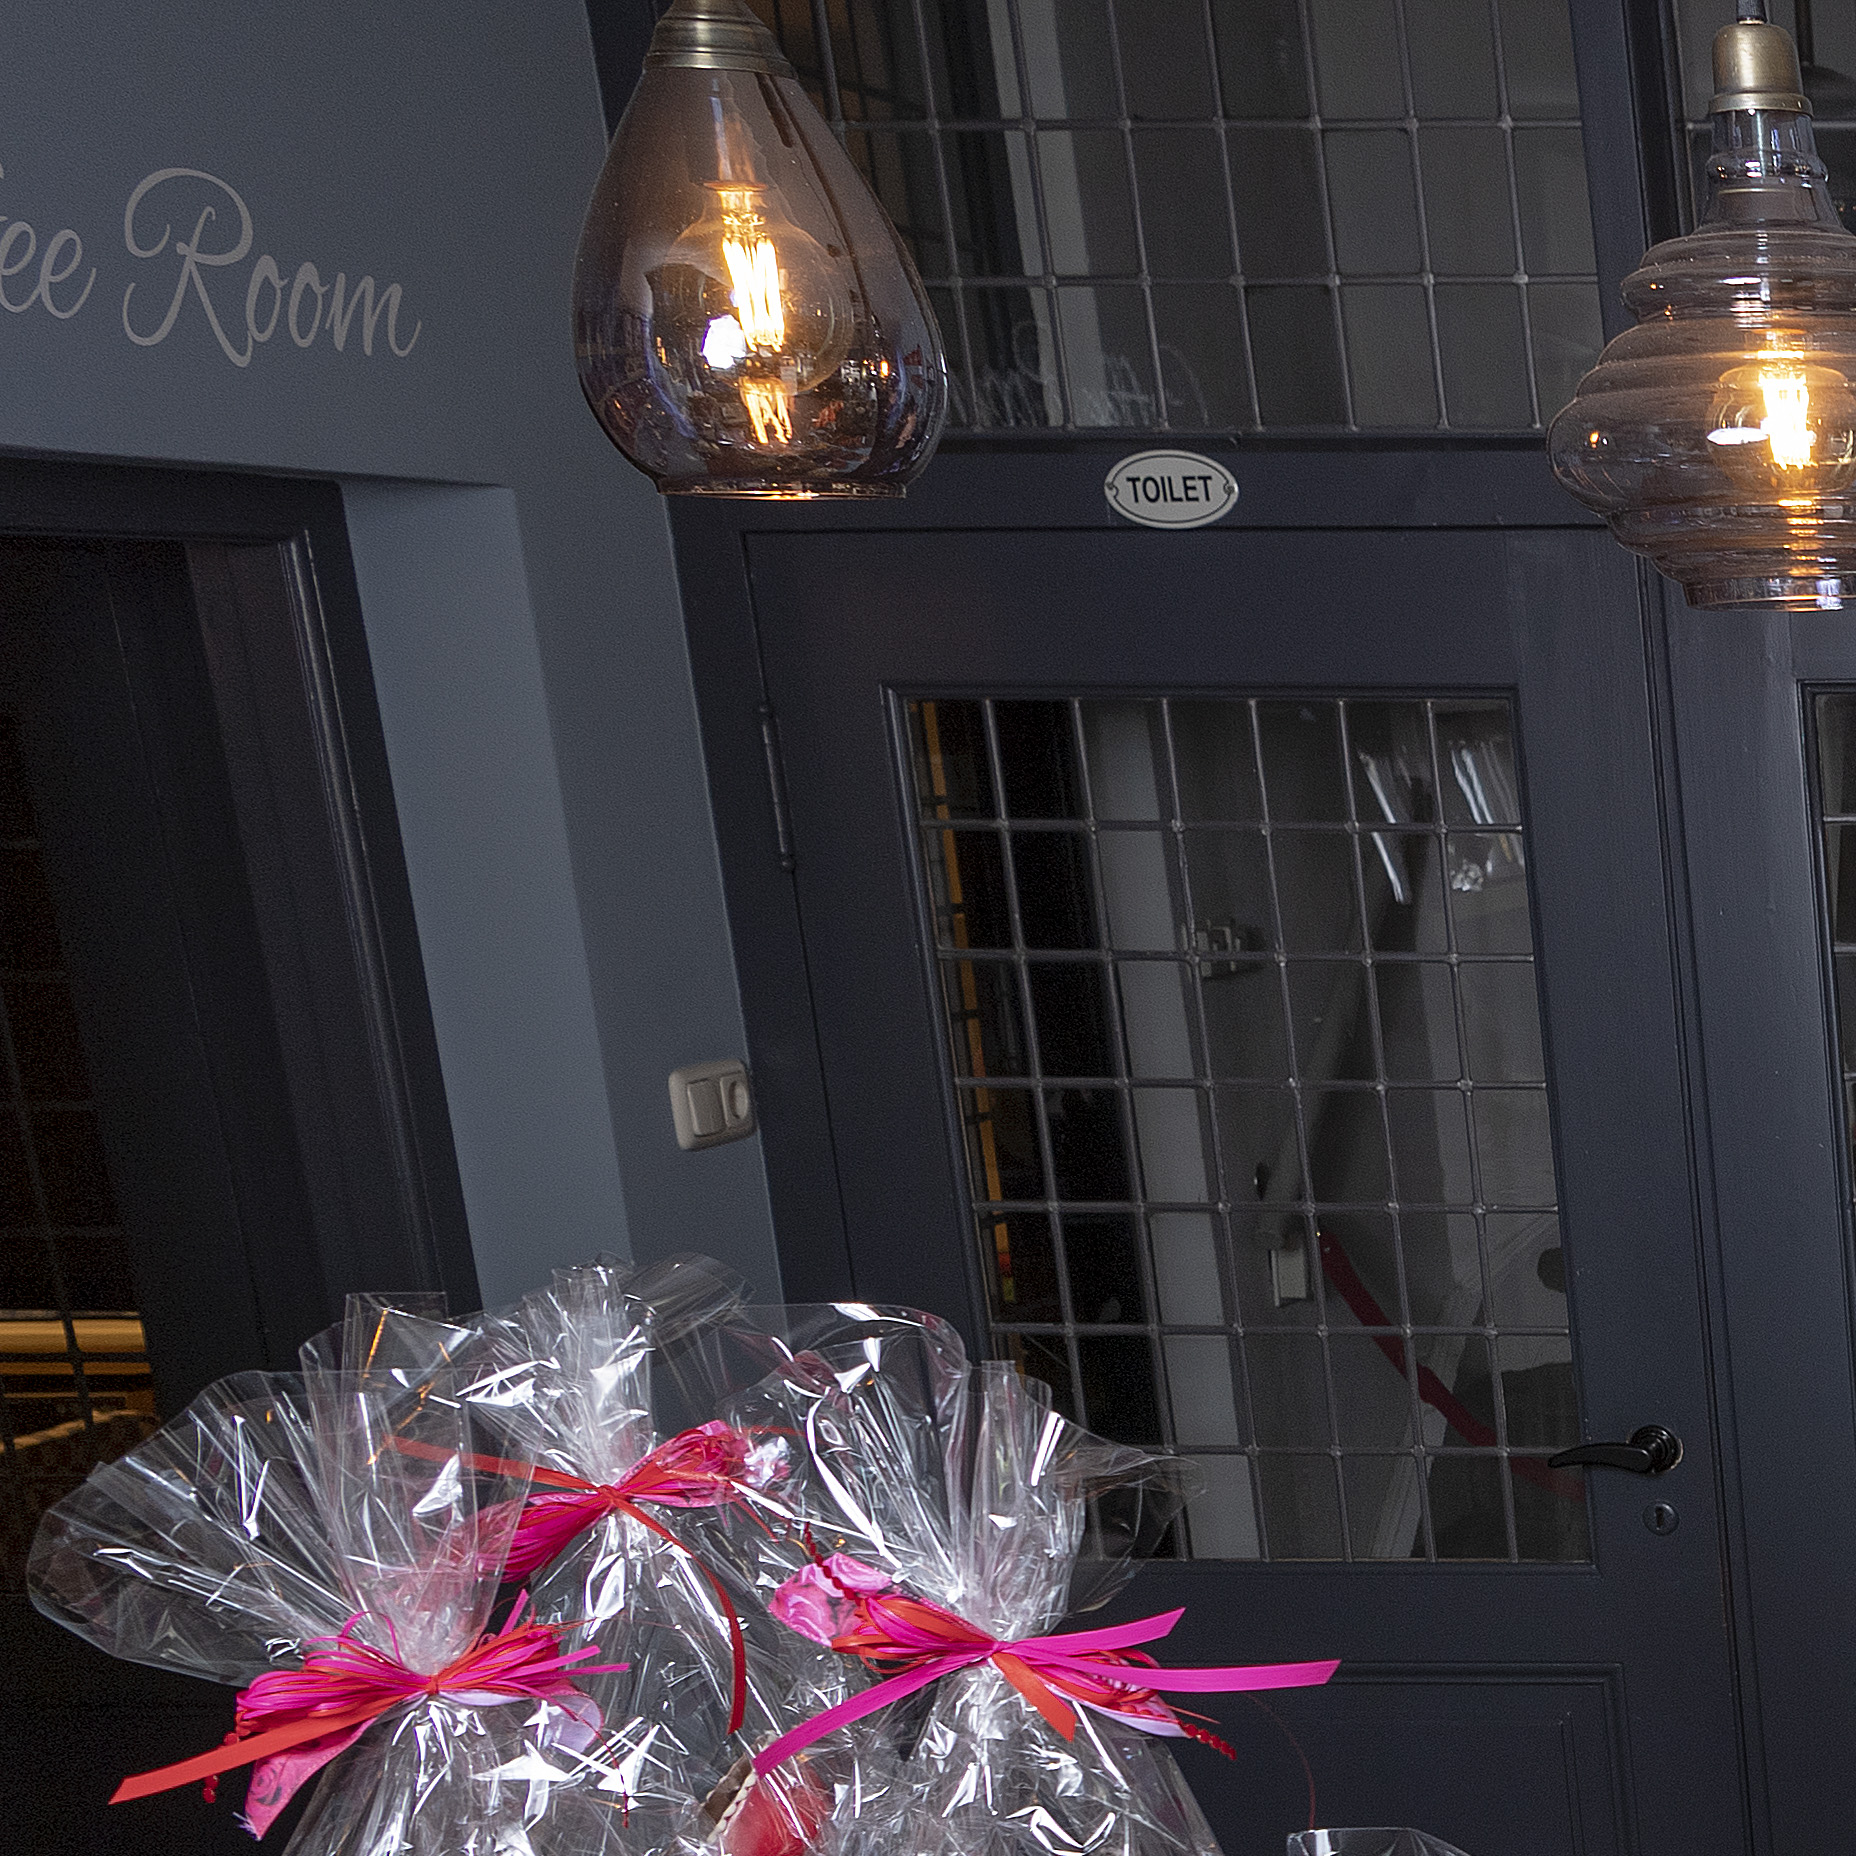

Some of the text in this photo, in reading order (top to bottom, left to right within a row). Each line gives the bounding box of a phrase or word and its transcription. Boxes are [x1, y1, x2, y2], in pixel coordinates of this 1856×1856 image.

[0, 168, 421, 367] ee Room
[1127, 476, 1212, 504] TOILET
